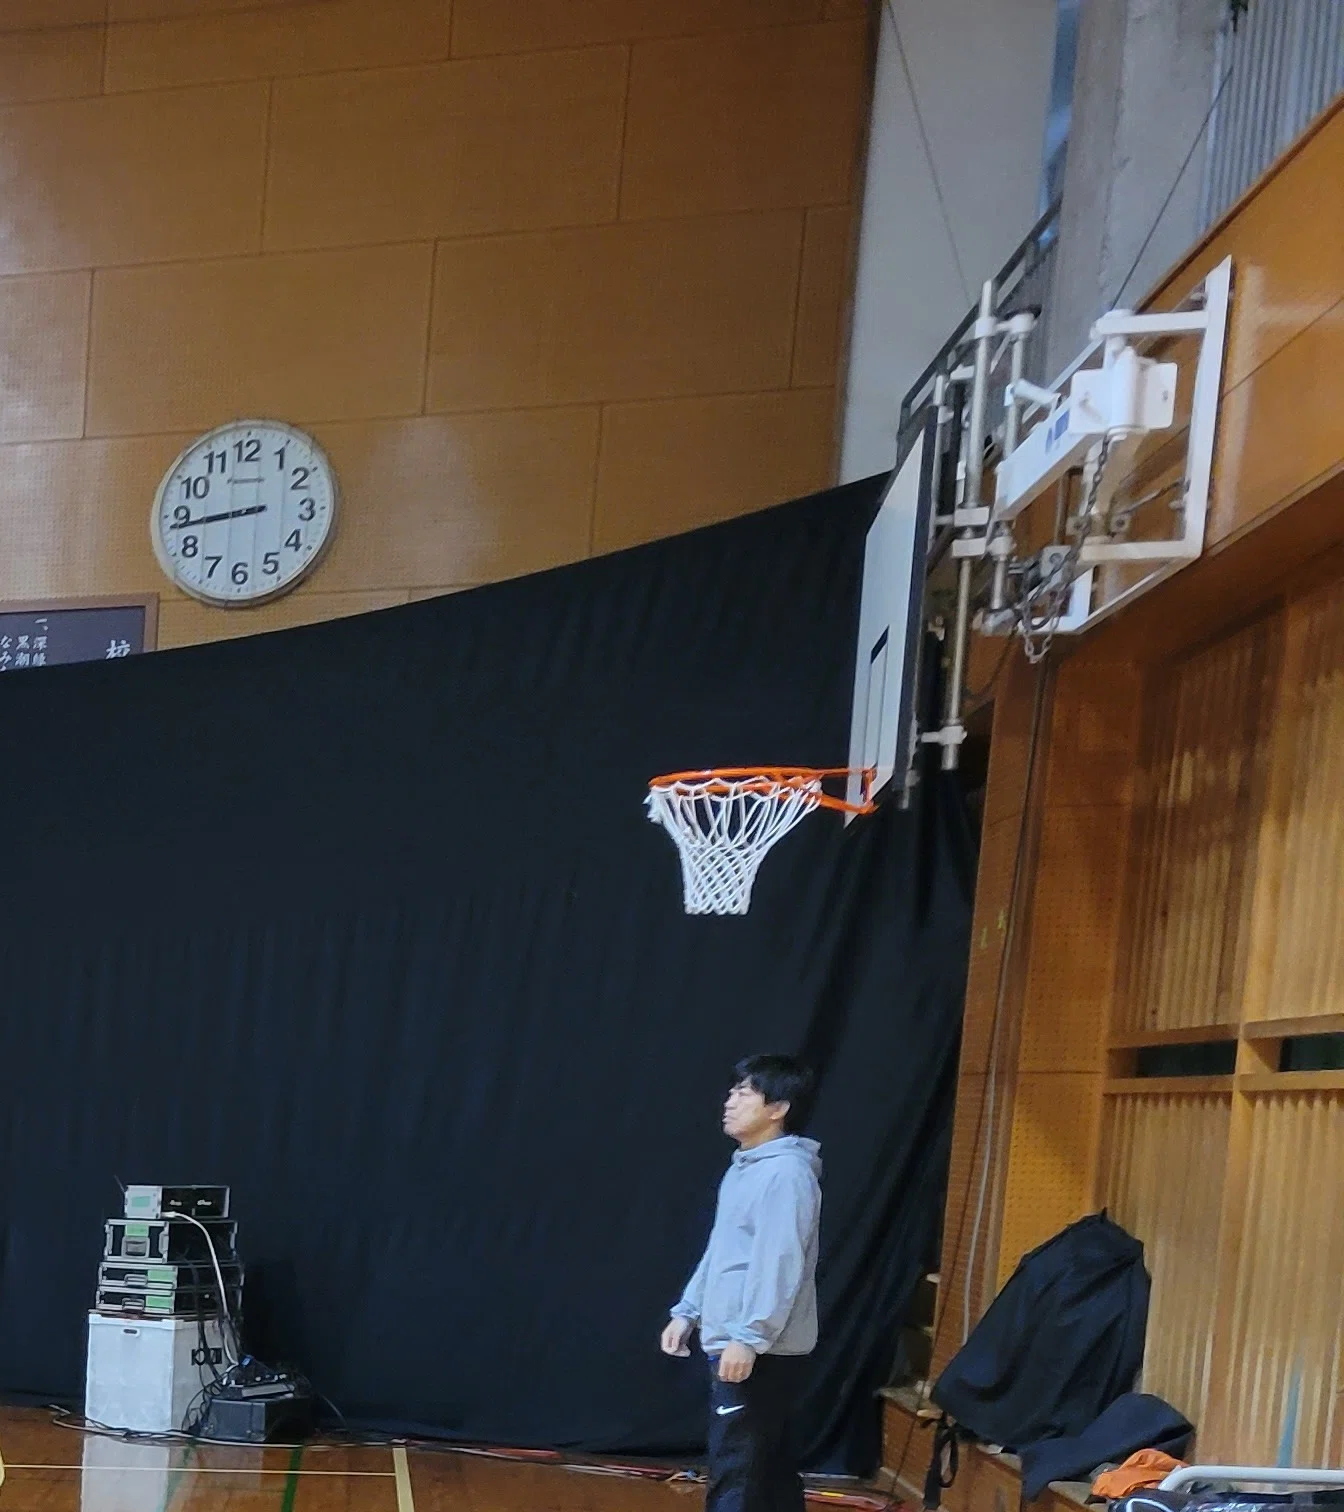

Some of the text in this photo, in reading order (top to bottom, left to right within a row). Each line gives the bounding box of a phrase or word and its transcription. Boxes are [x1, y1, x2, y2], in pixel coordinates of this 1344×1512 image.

[203, 450, 227, 474] 11
[233, 439, 261, 463] 12
[274, 448, 286, 470] 1
[180, 475, 210, 500] 10
[290, 467, 310, 490] 2
[173, 505, 191, 526] 9
[298, 498, 316, 521] 3
[181, 535, 199, 558] 8
[284, 528, 303, 552] 4
[204, 556, 223, 579] 7
[231, 562, 249, 585] 6
[262, 551, 281, 575] 5
